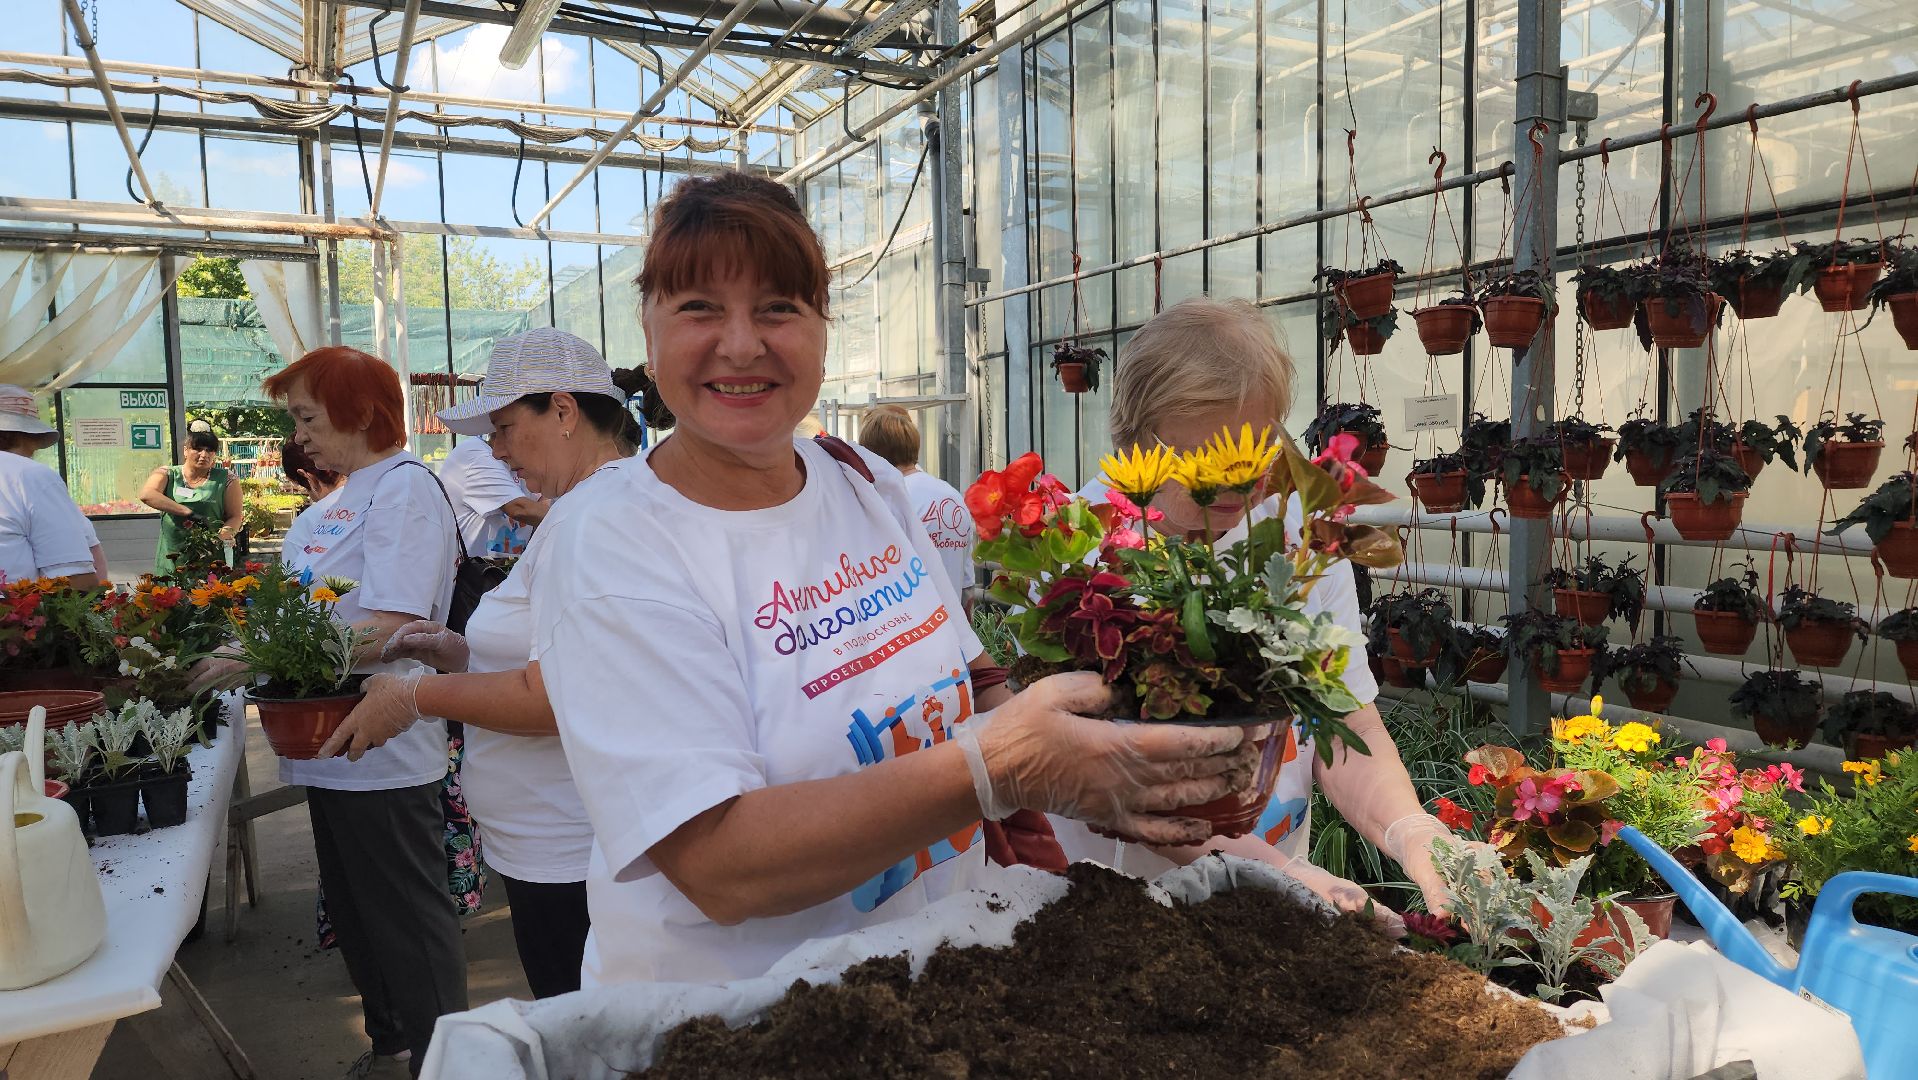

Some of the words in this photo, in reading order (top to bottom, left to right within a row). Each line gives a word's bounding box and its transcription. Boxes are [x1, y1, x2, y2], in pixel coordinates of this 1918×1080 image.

[121, 392, 166, 408] ВЫХОД
[754, 544, 901, 629] Активное
[809, 659, 864, 693] ПРОЕКТ
[868, 607, 948, 664] ГУБЕРНАТО
